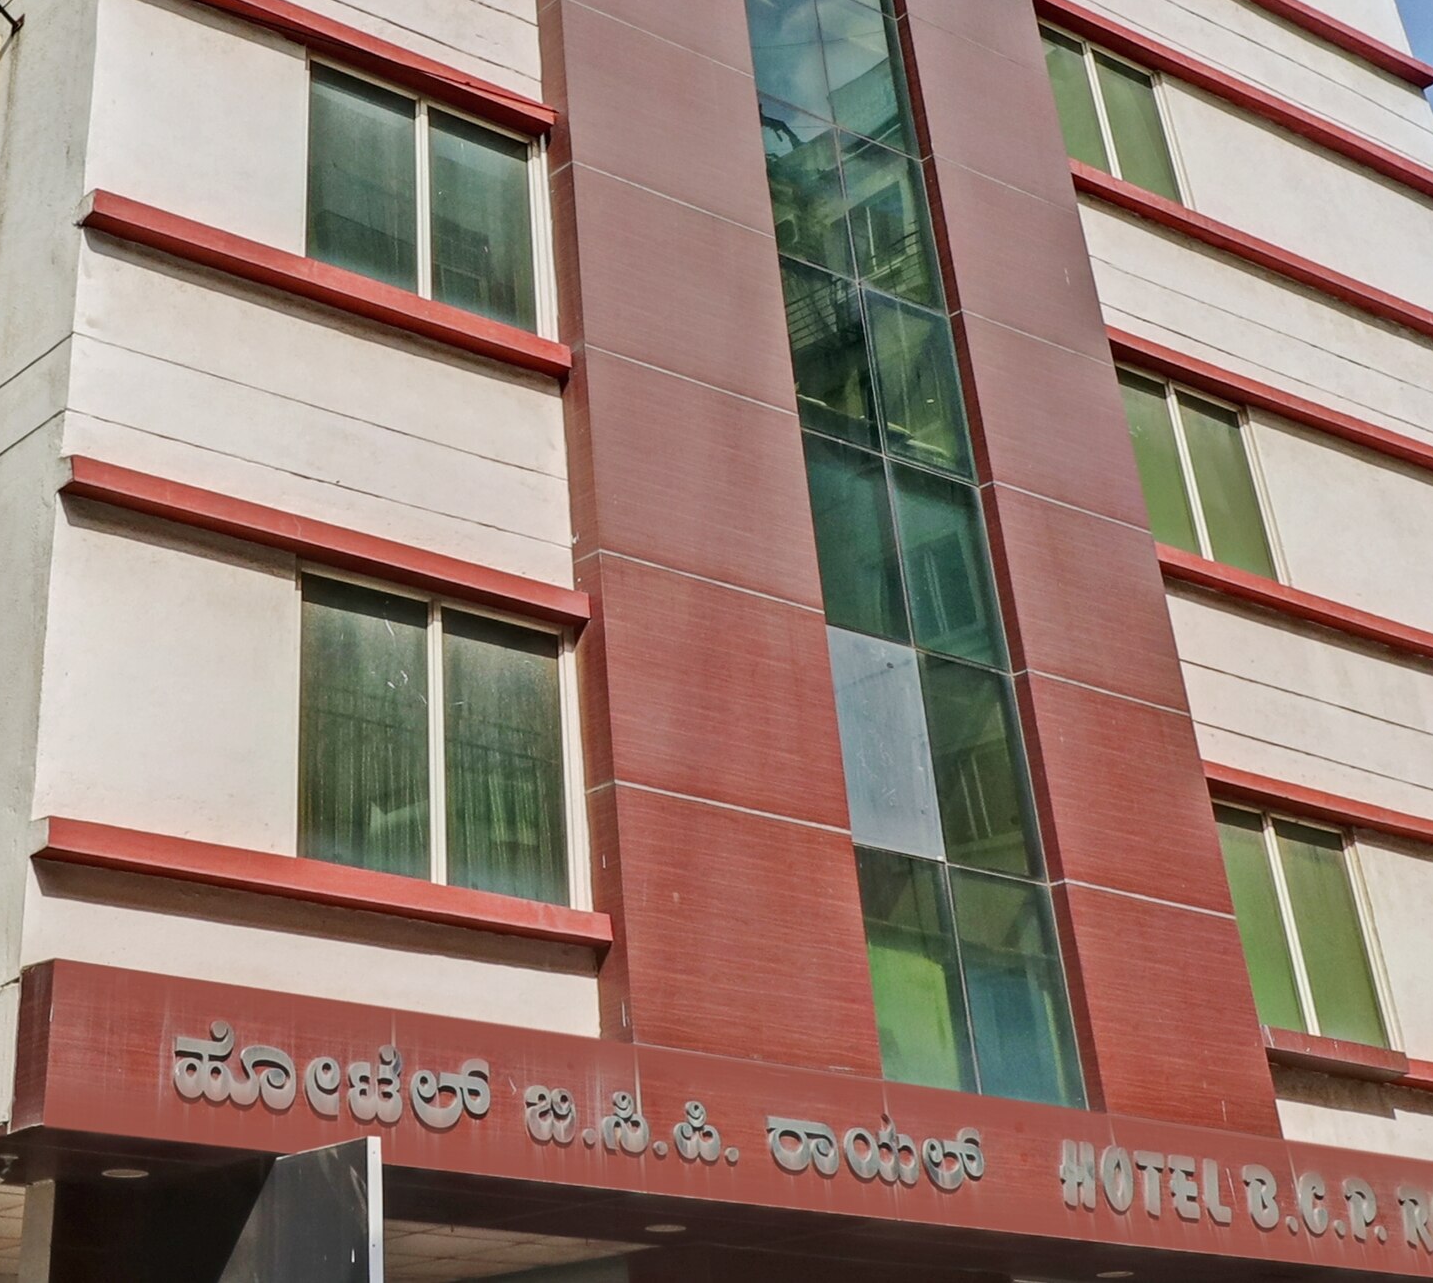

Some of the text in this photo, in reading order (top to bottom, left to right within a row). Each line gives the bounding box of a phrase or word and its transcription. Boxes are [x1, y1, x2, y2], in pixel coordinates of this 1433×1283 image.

[173, 1020, 491, 1129] ಹೋಟೆಲ್
[765, 1110, 985, 1190] ರಾಯಲ್
[1060, 1139, 1232, 1227] HOTEL
